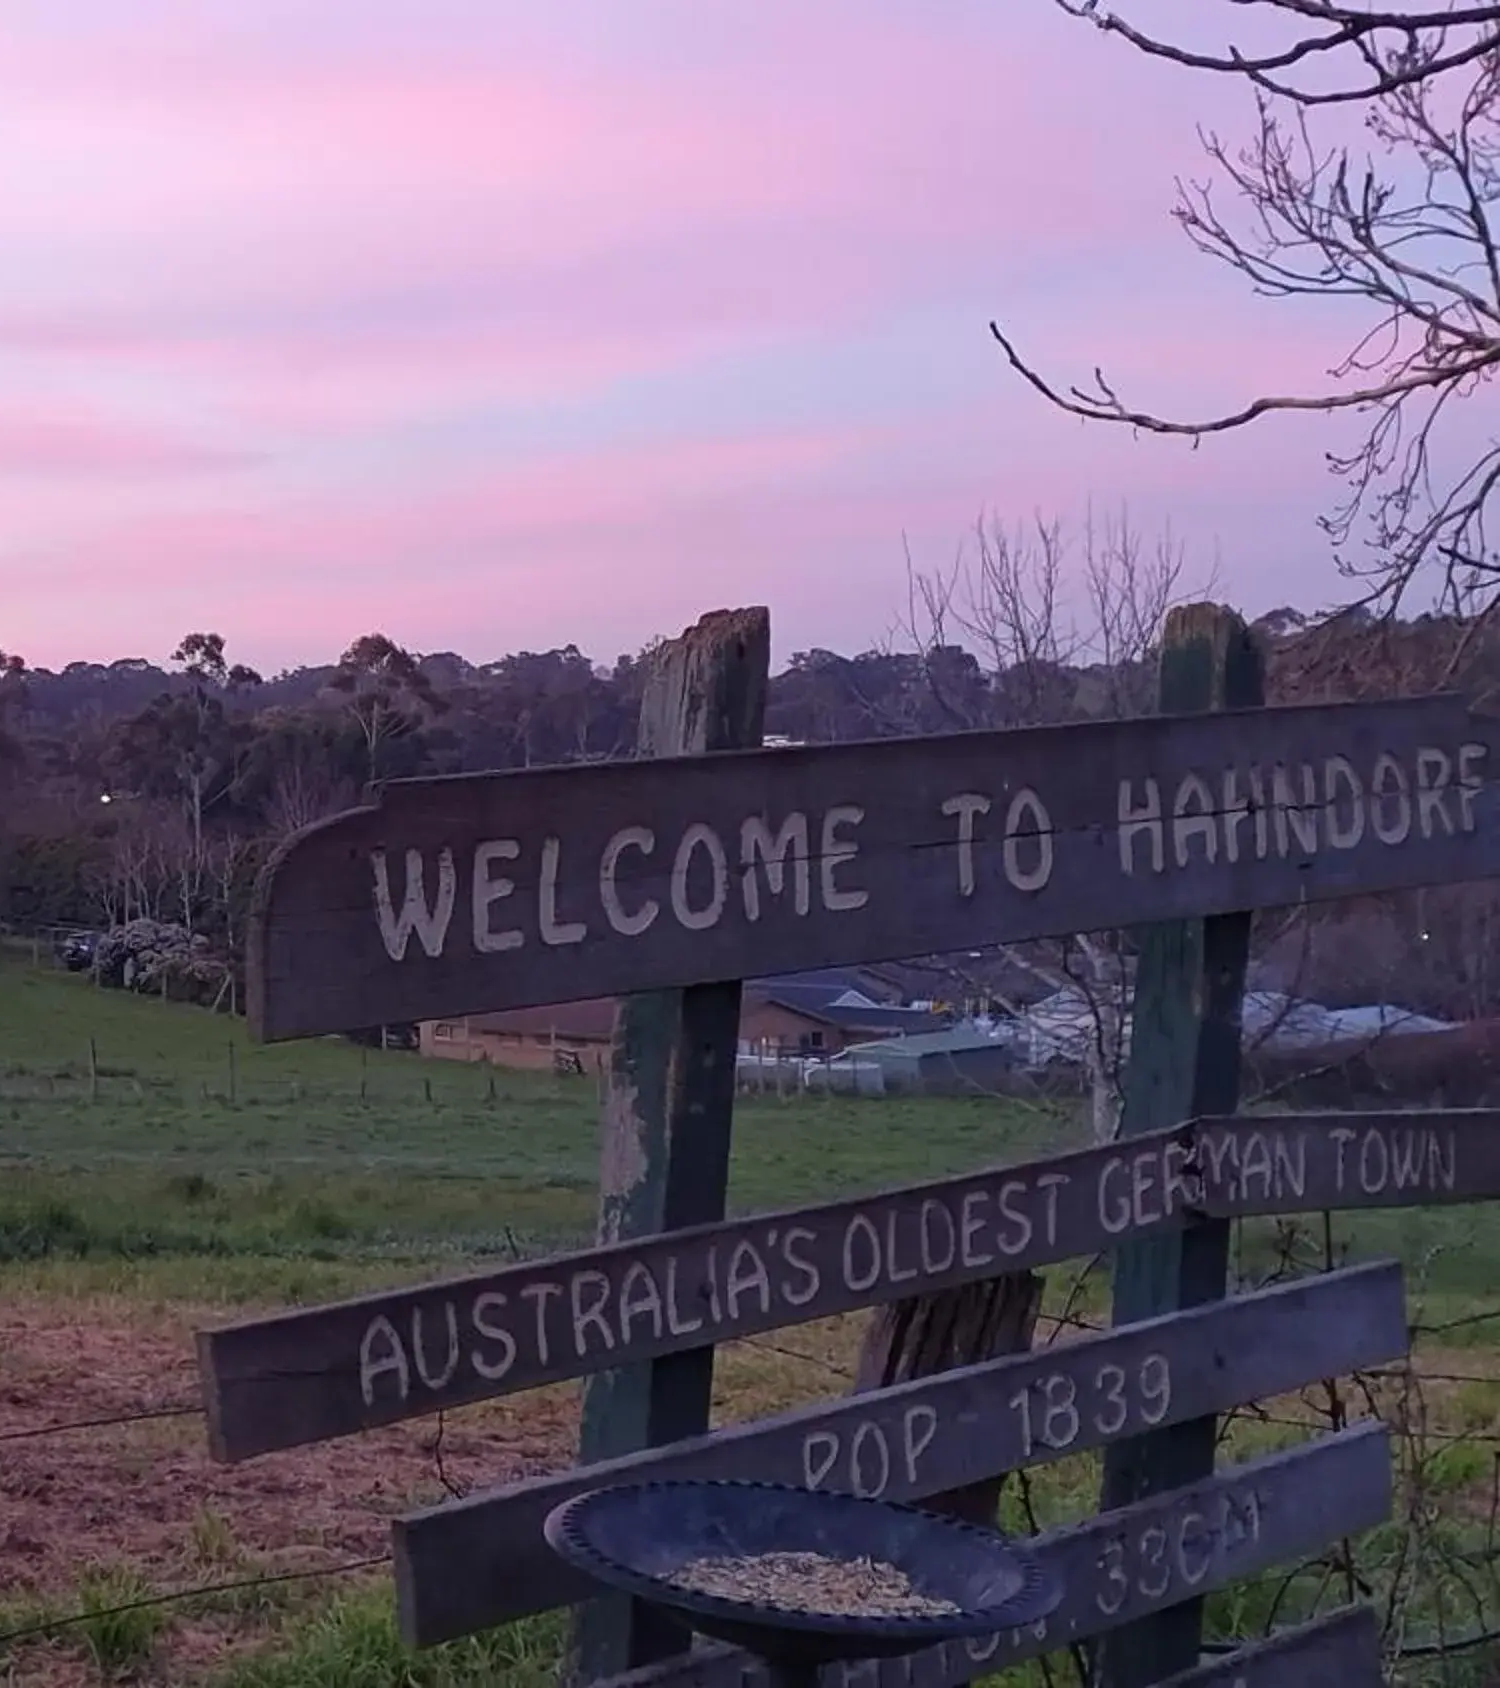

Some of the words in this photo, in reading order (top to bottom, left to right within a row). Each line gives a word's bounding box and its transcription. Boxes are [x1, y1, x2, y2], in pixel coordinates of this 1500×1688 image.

[371, 803, 869, 962] WELCOME
[941, 786, 1054, 897] TO
[1117, 742, 1490, 877] HAHNDORF
[359, 1228, 821, 1407] AUSTRALIA'S
[842, 1171, 1071, 1292] OLDEST
[1096, 1128, 1307, 1235] GERMAN
[1328, 1126, 1457, 1195] TOWN
[802, 1403, 938, 1499] POP
[1008, 1351, 1172, 1457] 1839
